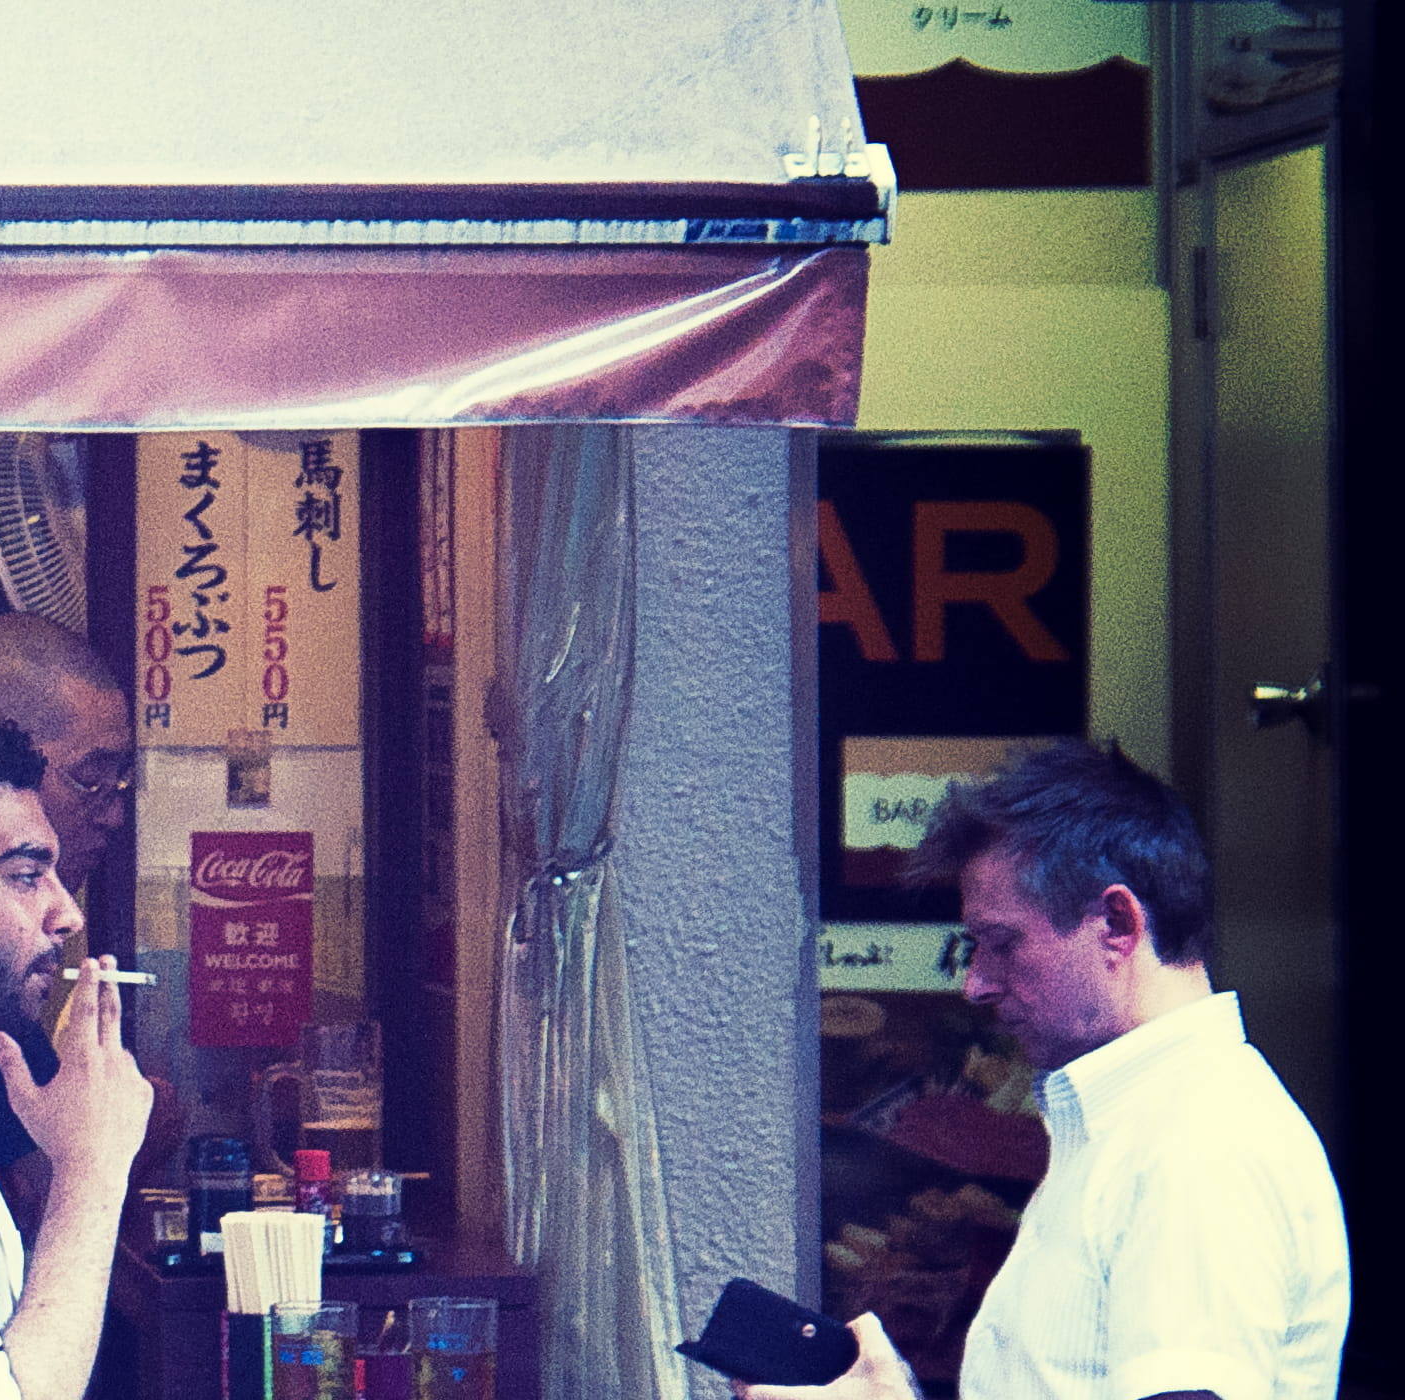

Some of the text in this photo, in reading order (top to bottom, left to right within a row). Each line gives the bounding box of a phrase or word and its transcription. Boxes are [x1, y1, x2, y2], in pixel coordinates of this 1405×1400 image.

[292, 438, 345, 593] 馬刺し
[145, 585, 173, 729] 500円
[261, 584, 289, 730] 550円
[205, 953, 300, 970] WELCOME
